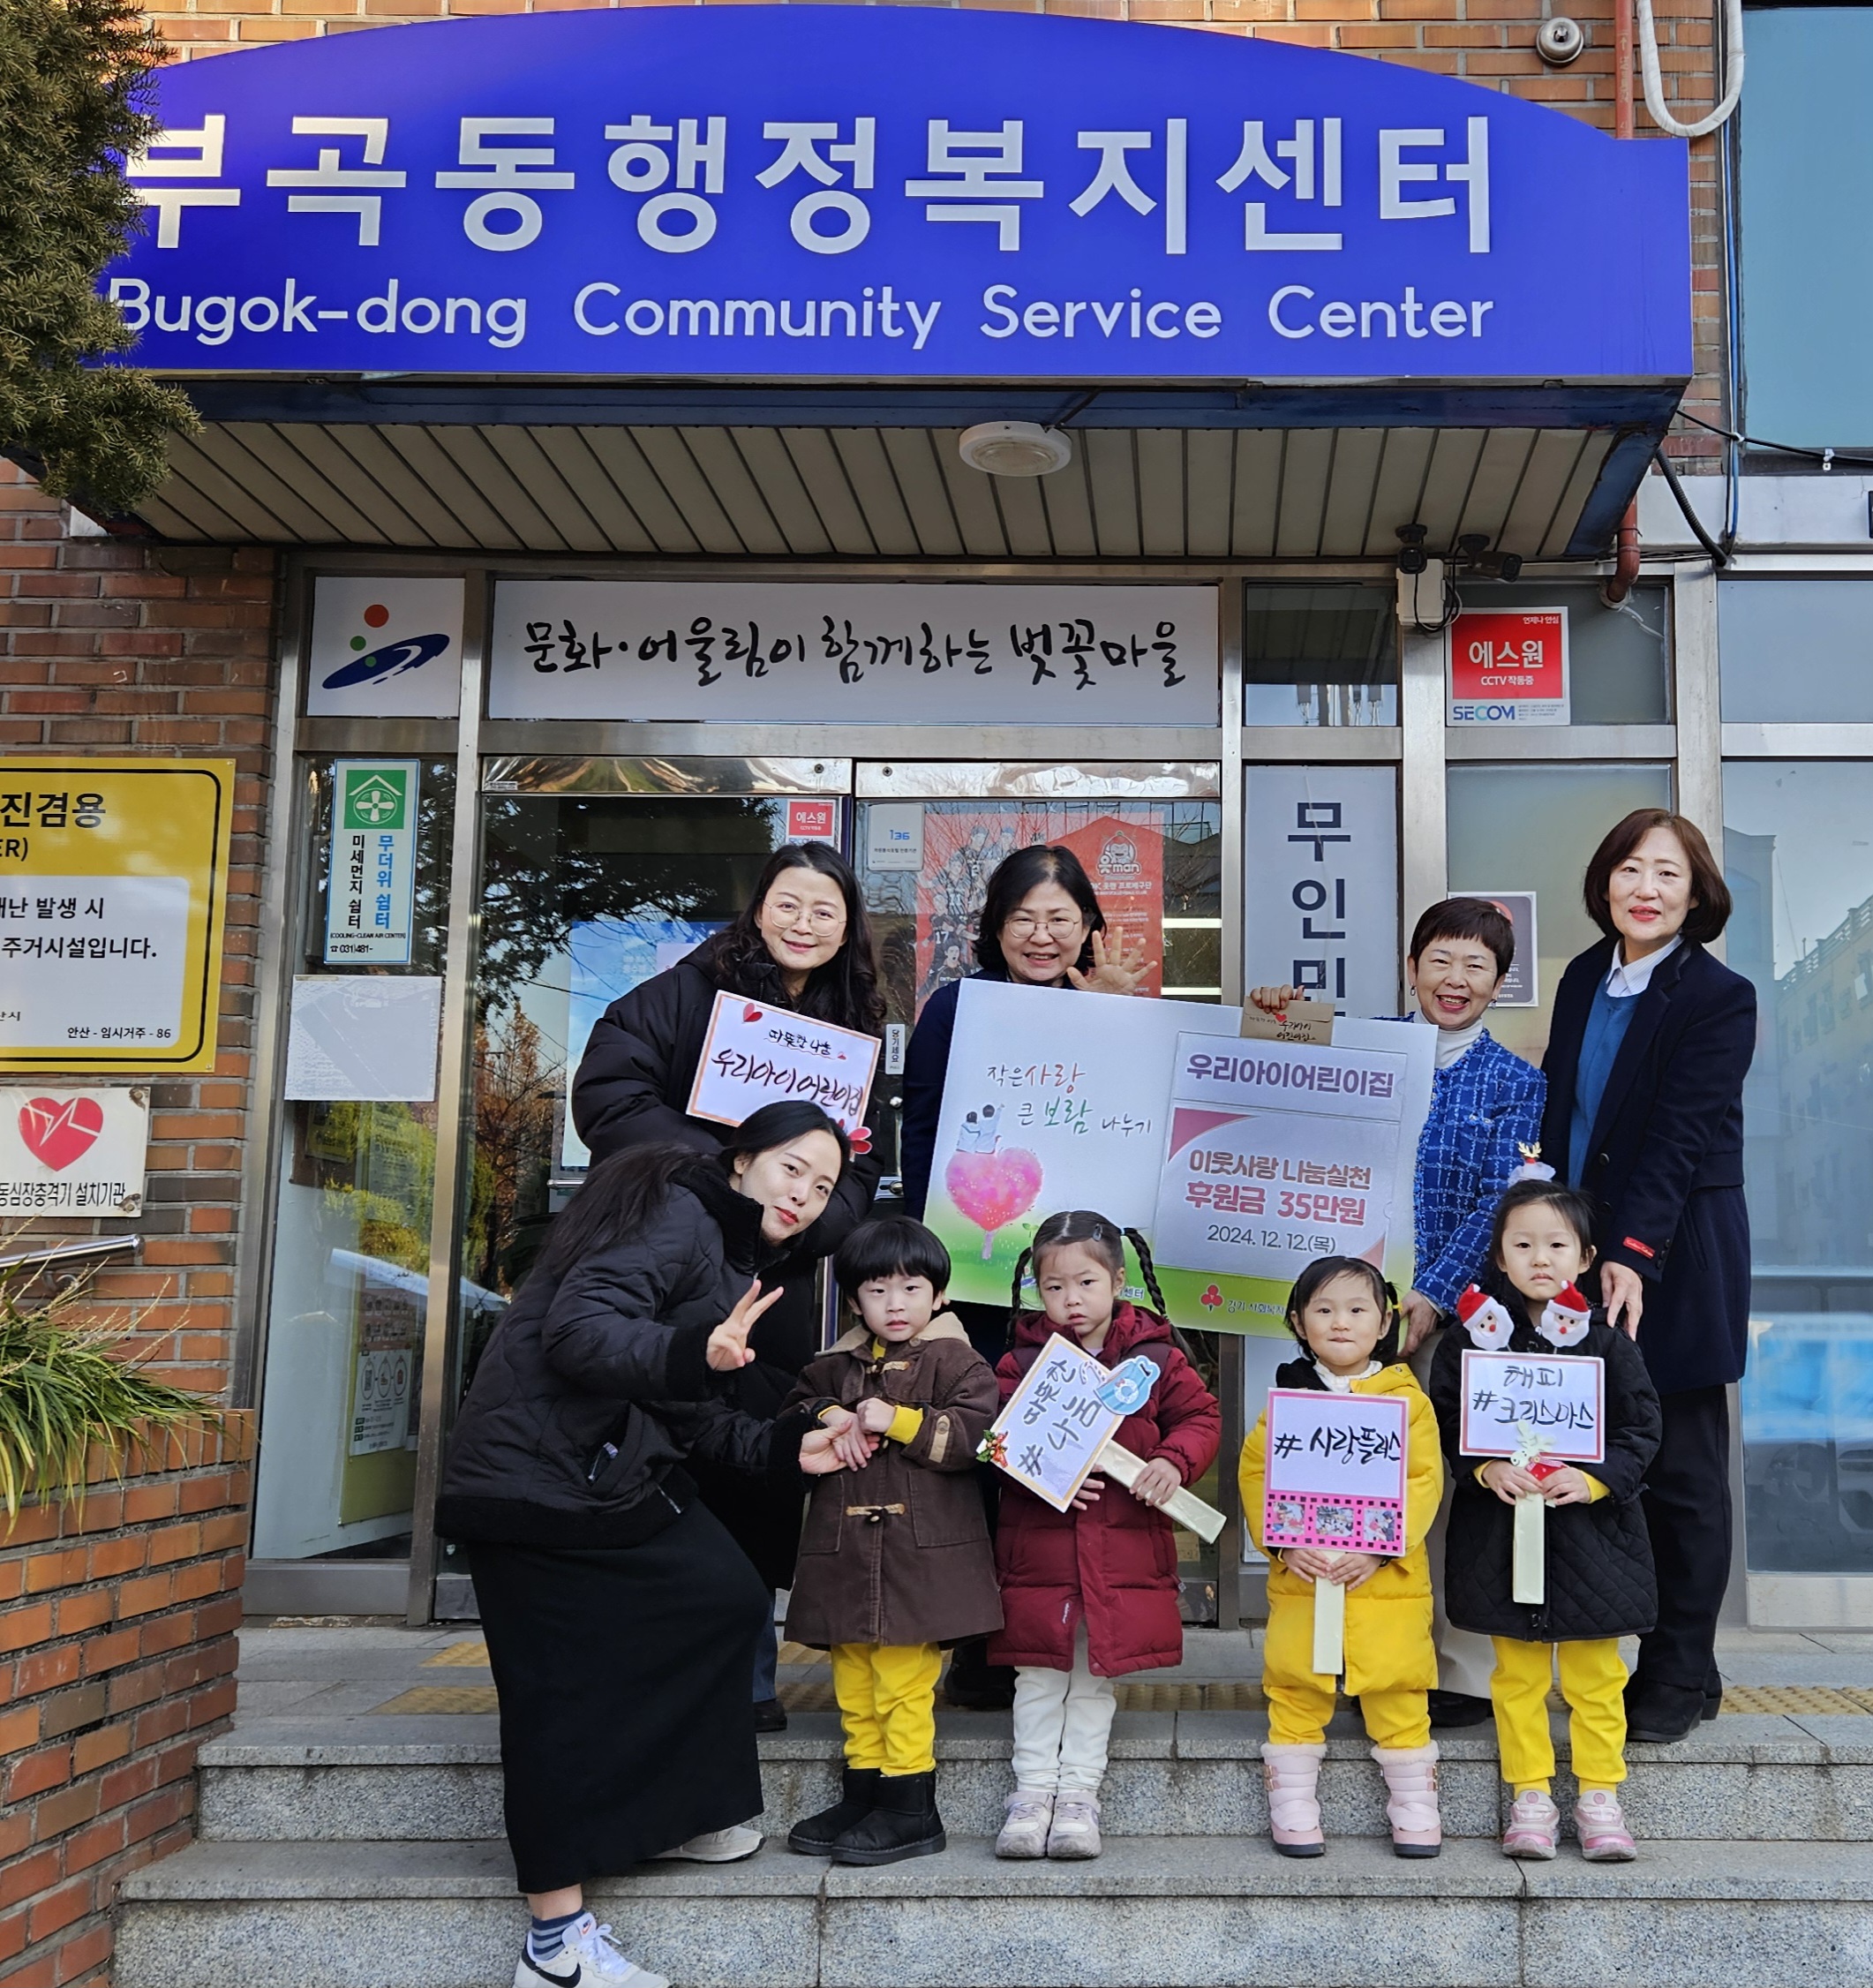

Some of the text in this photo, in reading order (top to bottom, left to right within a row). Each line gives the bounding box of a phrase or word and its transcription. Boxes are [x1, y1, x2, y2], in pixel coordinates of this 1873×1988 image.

[122, 113, 1491, 256] 부곡동행정복지센터
[108, 277, 1494, 350] Bugok-dong Community Service Center
[822, 614, 993, 684] 함께하는
[1469, 640, 1544, 669] 에스원
[1480, 675, 1535, 687] CCTV 작동중
[1453, 704, 1516, 721] SECOM
[0, 792, 106, 828] 진겸용
[795, 811, 826, 825] 에스원
[0, 837, 28, 862] R)
[347, 834, 365, 930] 미세먼지 쉼터
[374, 834, 395, 930] 무더위 쉼터
[36, 897, 77, 920] 발생
[85, 897, 104, 920] 시
[2, 937, 157, 960] 주거시설입니다.
[67, 1026, 90, 1040] 안산
[101, 1026, 147, 1040] 임시거주
[155, 1028, 171, 1039] 86
[768, 1028, 809, 1050] 따뜻한
[1186, 1053, 1395, 1098] 우리아이어린이집
[1017, 1102, 1034, 1126] 큰
[1102, 1113, 1152, 1138] 나누기
[1189, 1148, 1372, 1191] 이웃사랑 나눔실천
[76, 1182, 125, 1207] 설치기관
[1185, 1180, 1366, 1227] 후원금 35만원
[1503, 1365, 1563, 1389] 해피
